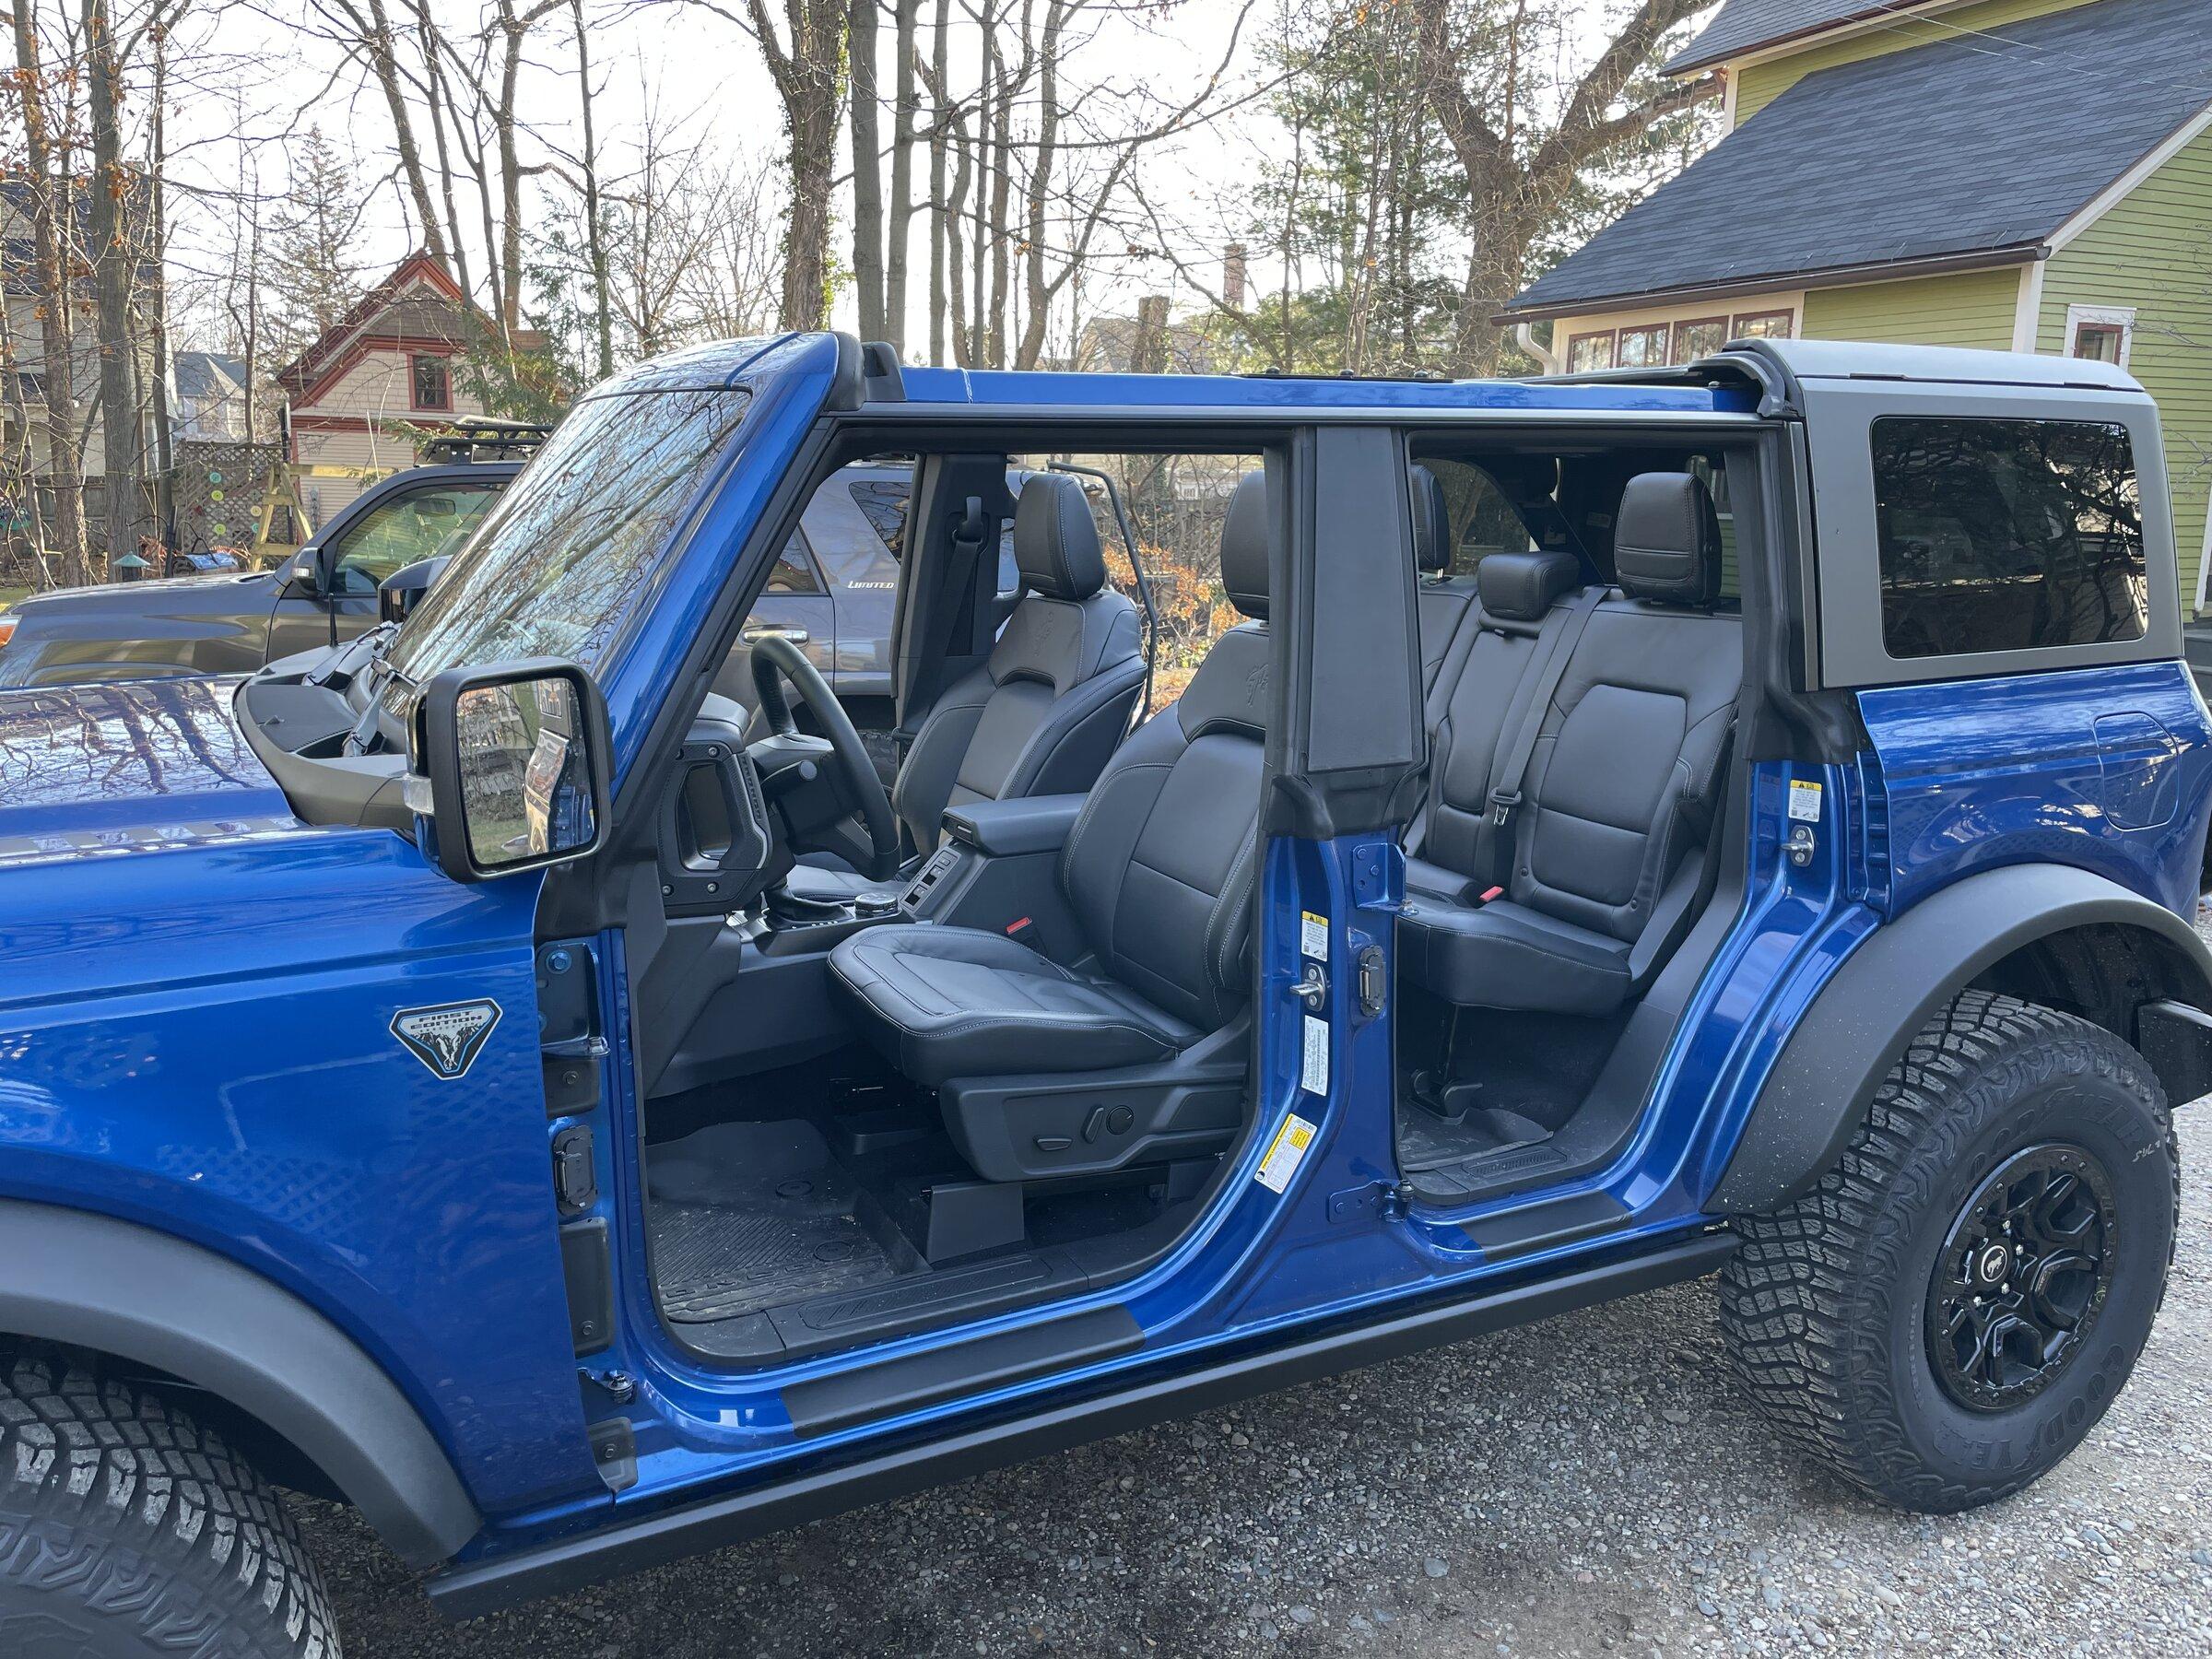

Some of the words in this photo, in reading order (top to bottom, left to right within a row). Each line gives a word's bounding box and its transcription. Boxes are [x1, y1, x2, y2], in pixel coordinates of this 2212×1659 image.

[847, 580, 895, 589] LIMITED
[410, 1014, 483, 1030] EDITION
[418, 1010, 474, 1023] FIRST
[1933, 1343, 2125, 1475] GOODYEAR
